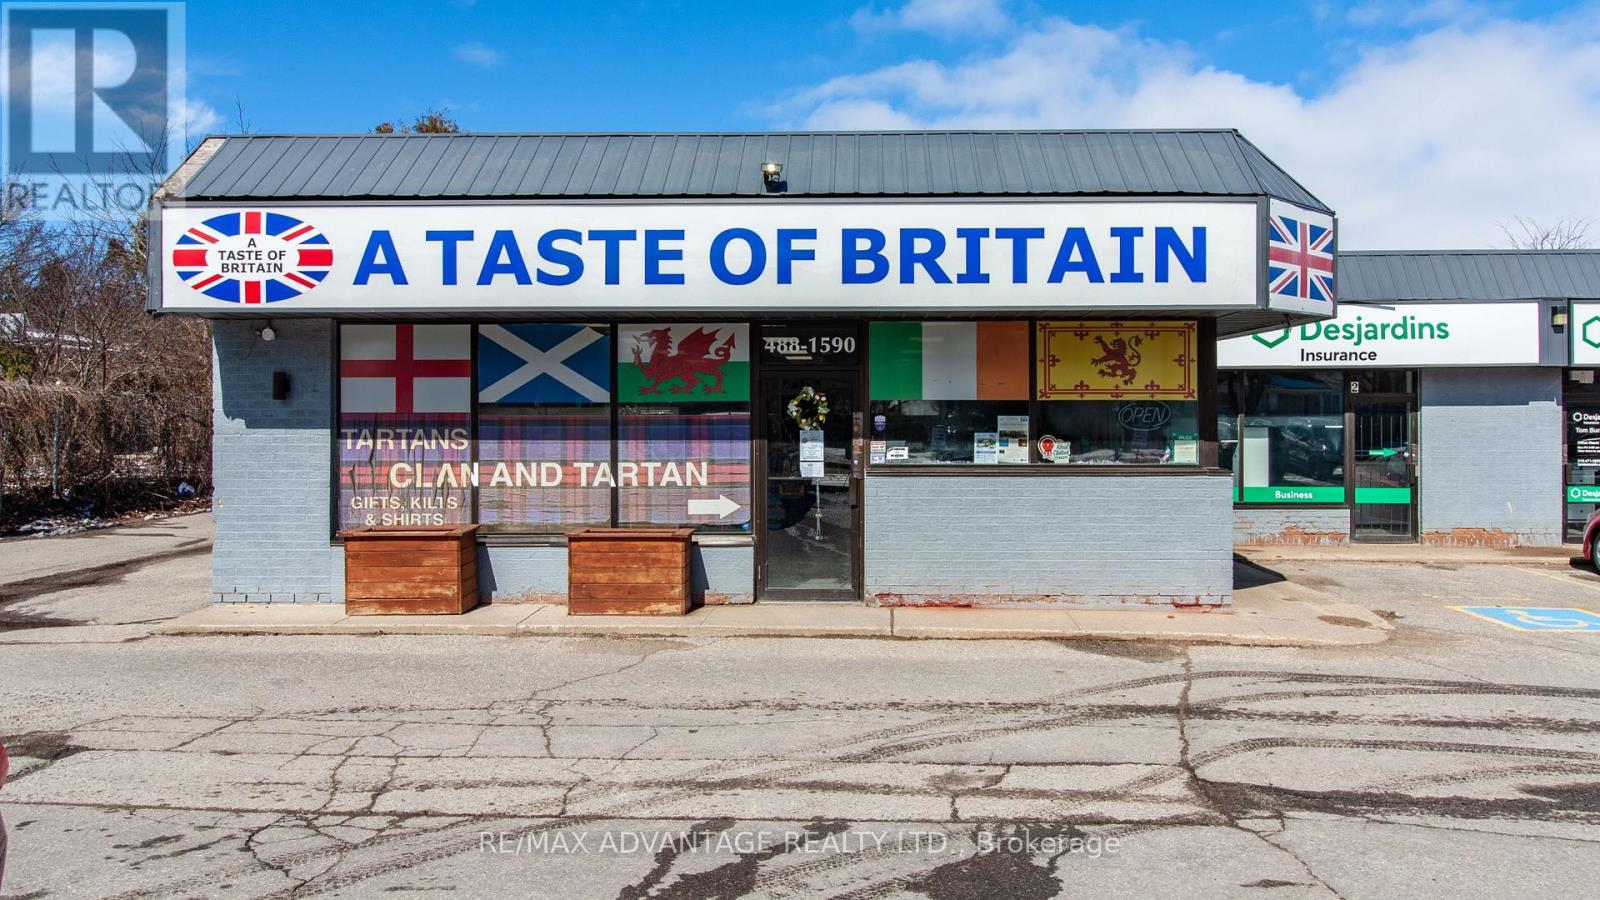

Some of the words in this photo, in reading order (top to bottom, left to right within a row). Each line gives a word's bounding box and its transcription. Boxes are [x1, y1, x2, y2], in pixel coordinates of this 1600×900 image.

[247, 237, 257, 248] A
[217, 250, 263, 261] TASTE
[267, 250, 287, 261] OF
[353, 229, 409, 286] A
[425, 228, 685, 286] TASTE
[709, 227, 818, 286] OF
[841, 226, 1207, 285] BRITAIN
[221, 262, 283, 273] BRITAIN
[1300, 315, 1450, 346] Desjardins
[763, 336, 856, 354] 488-1590
[1300, 348, 1378, 362] Insurance
[1351, 382, 1359, 393] 2
[1121, 406, 1166, 423] OPEN
[341, 428, 469, 450] TARTANS
[390, 462, 479, 488] CLAN
[490, 462, 563, 487] AND
[573, 462, 708, 487] TARTAN
[1274, 490, 1313, 499] Business
[351, 497, 405, 511] GIFTS,
[410, 497, 458, 510] KILTS
[365, 514, 377, 526] &
[382, 514, 444, 526] SHIRTS
